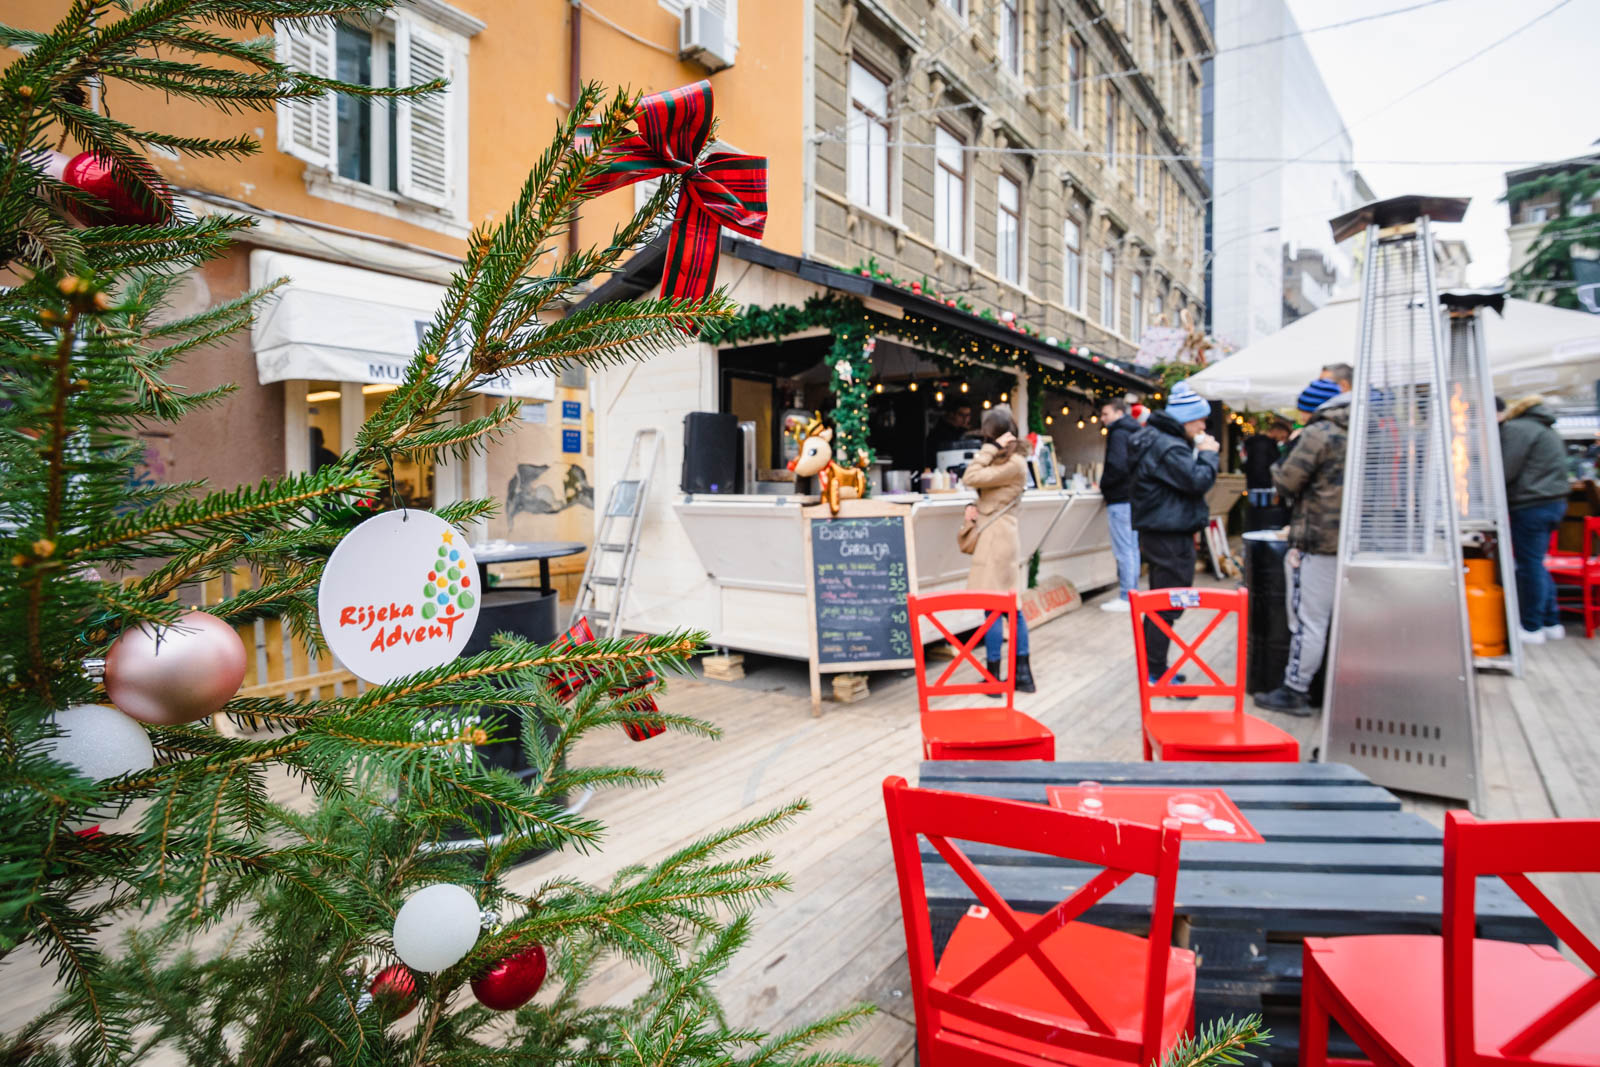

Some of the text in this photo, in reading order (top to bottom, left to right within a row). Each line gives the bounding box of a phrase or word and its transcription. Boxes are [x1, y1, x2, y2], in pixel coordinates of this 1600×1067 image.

[889, 562, 904, 576] 27
[888, 577, 907, 591] 35
[339, 602, 414, 632] Rijeka
[370, 612, 464, 652] Advent
[889, 628, 907, 643] 30
